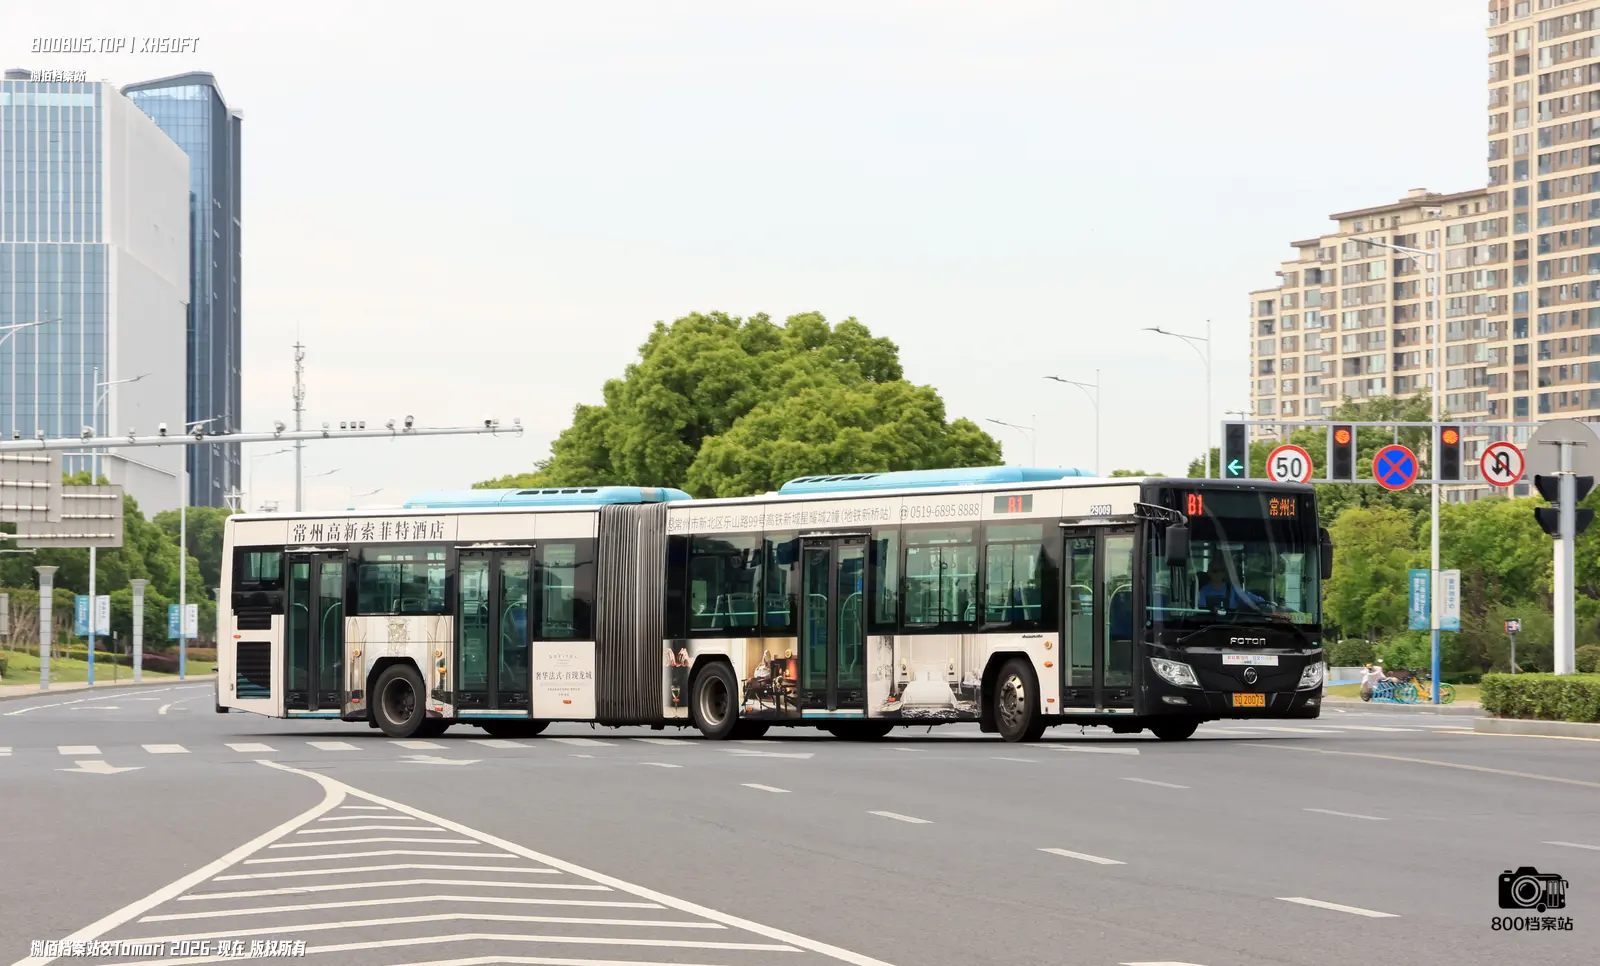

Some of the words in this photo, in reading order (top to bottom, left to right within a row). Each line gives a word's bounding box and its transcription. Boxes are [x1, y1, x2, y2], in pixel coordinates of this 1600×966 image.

[1276, 457, 1302, 478] 50
[910, 504, 956, 519] 0519-6895
[957, 503, 980, 516] 8888
[1090, 505, 1112, 516] 29009
[1187, 493, 1203, 516] B1
[293, 520, 445, 542] 常州高新索菲特酒店
[1230, 637, 1266, 645] FOTON
